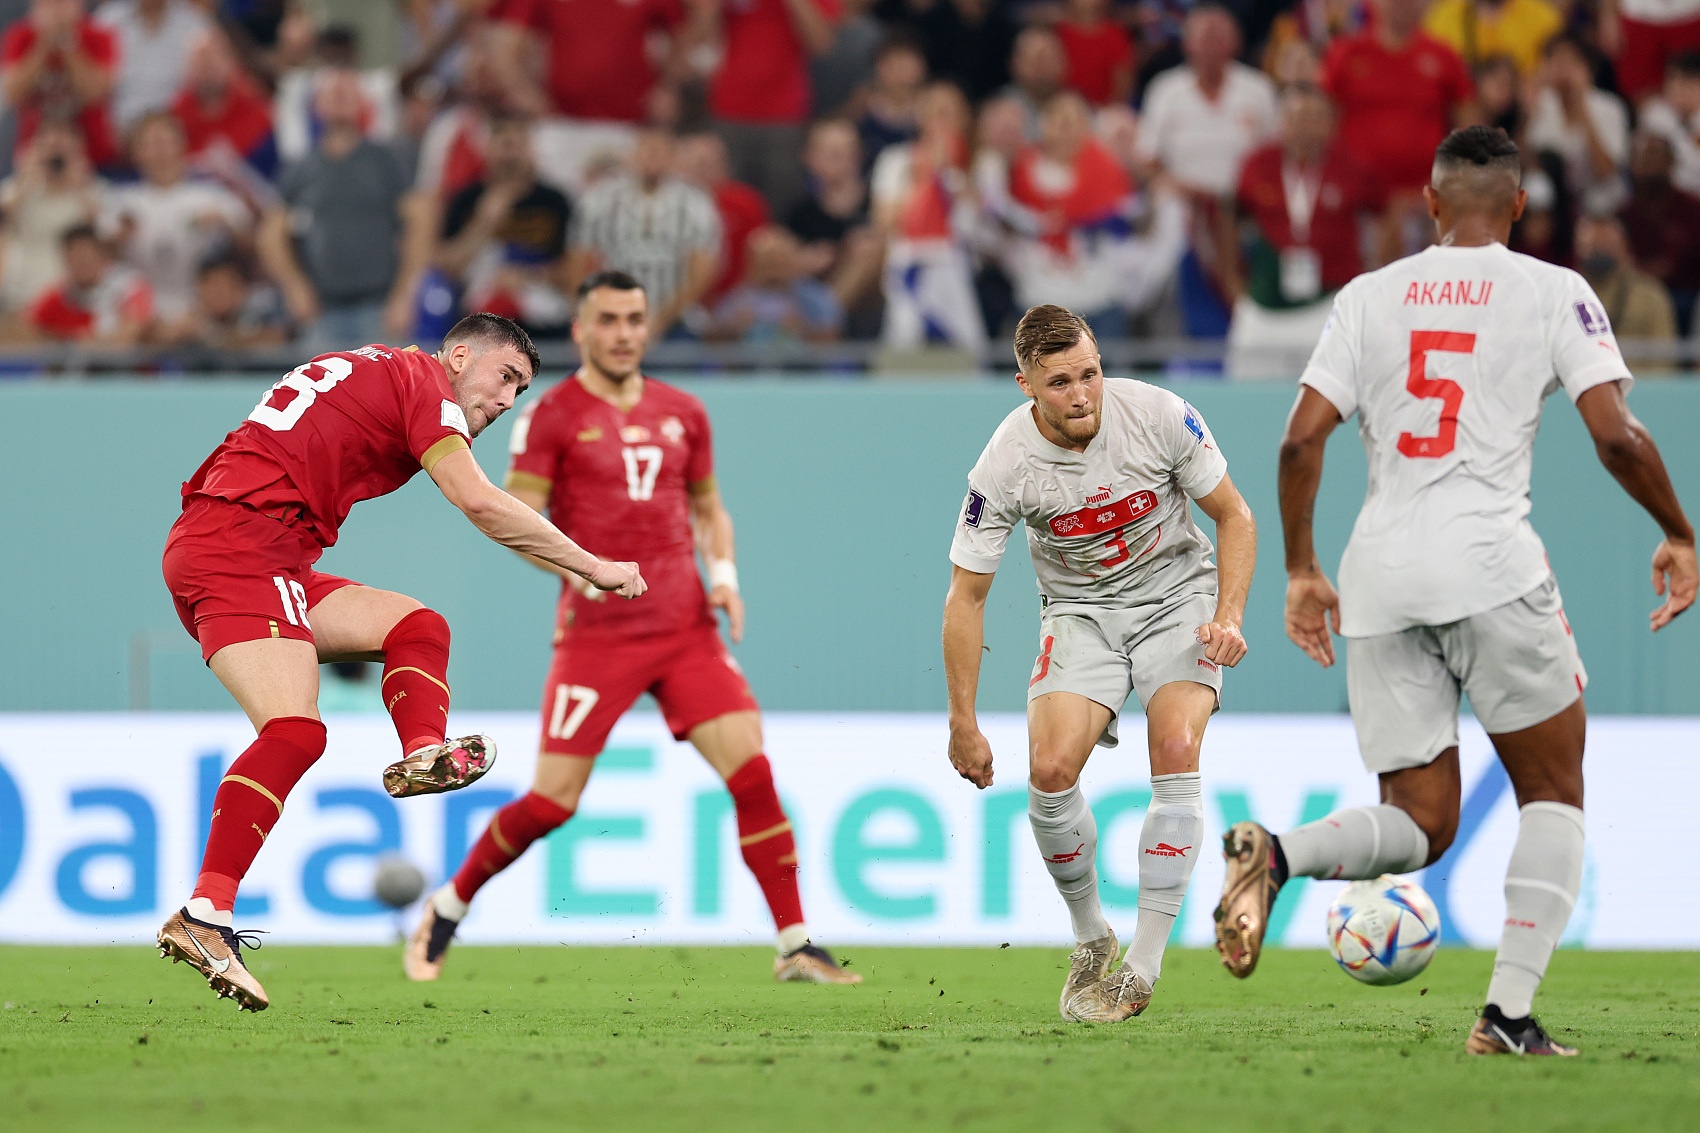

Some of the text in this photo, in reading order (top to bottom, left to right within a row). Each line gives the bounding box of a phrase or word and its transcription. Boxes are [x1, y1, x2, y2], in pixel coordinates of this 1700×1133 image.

[1403, 280, 1493, 306] AKANJI
[1396, 330, 1477, 459] 5
[622, 446, 664, 501] 17
[1085, 491, 1110, 504] PUMA
[1093, 525, 1131, 568] 3
[548, 683, 599, 740] 17
[1144, 848, 1177, 858] PUMA
